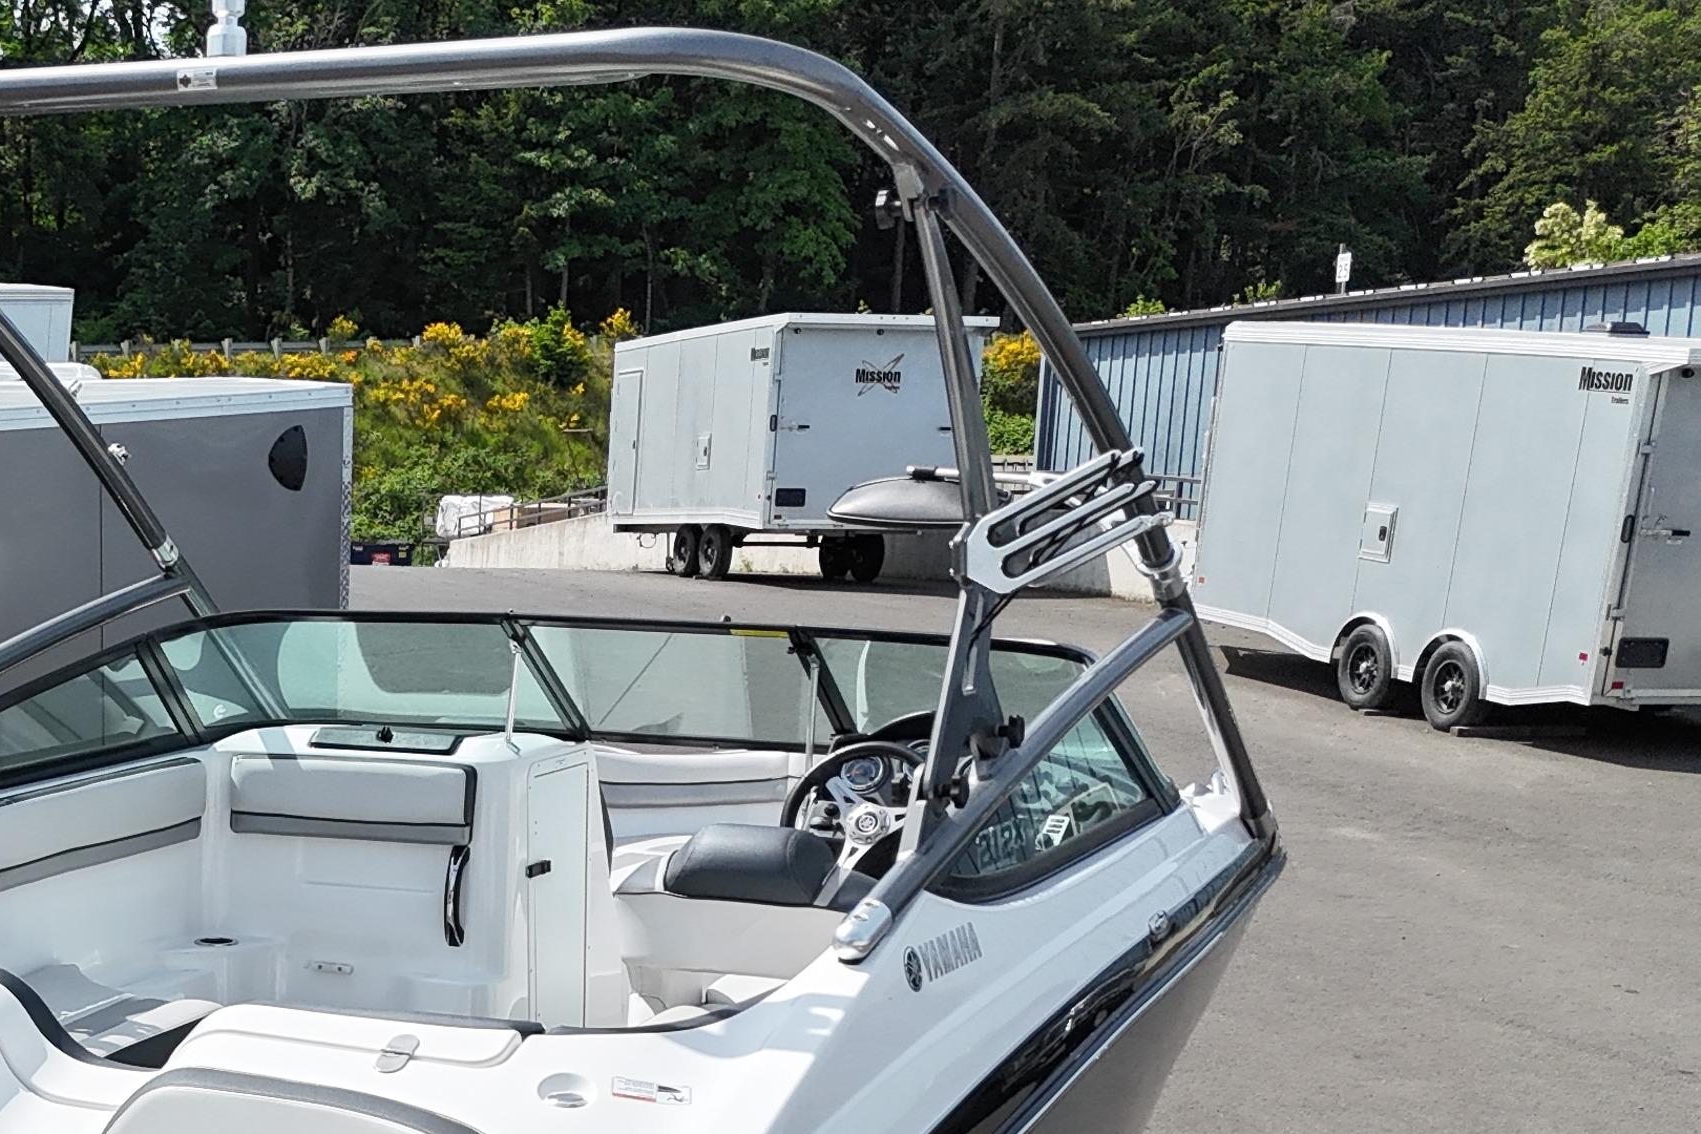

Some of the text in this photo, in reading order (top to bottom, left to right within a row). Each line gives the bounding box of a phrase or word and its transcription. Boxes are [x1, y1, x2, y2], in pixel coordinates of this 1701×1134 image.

[1338, 263, 1349, 279] 25
[855, 368, 901, 383] Mission
[1578, 366, 1633, 392] Mission
[917, 922, 983, 982] YAMAHA
